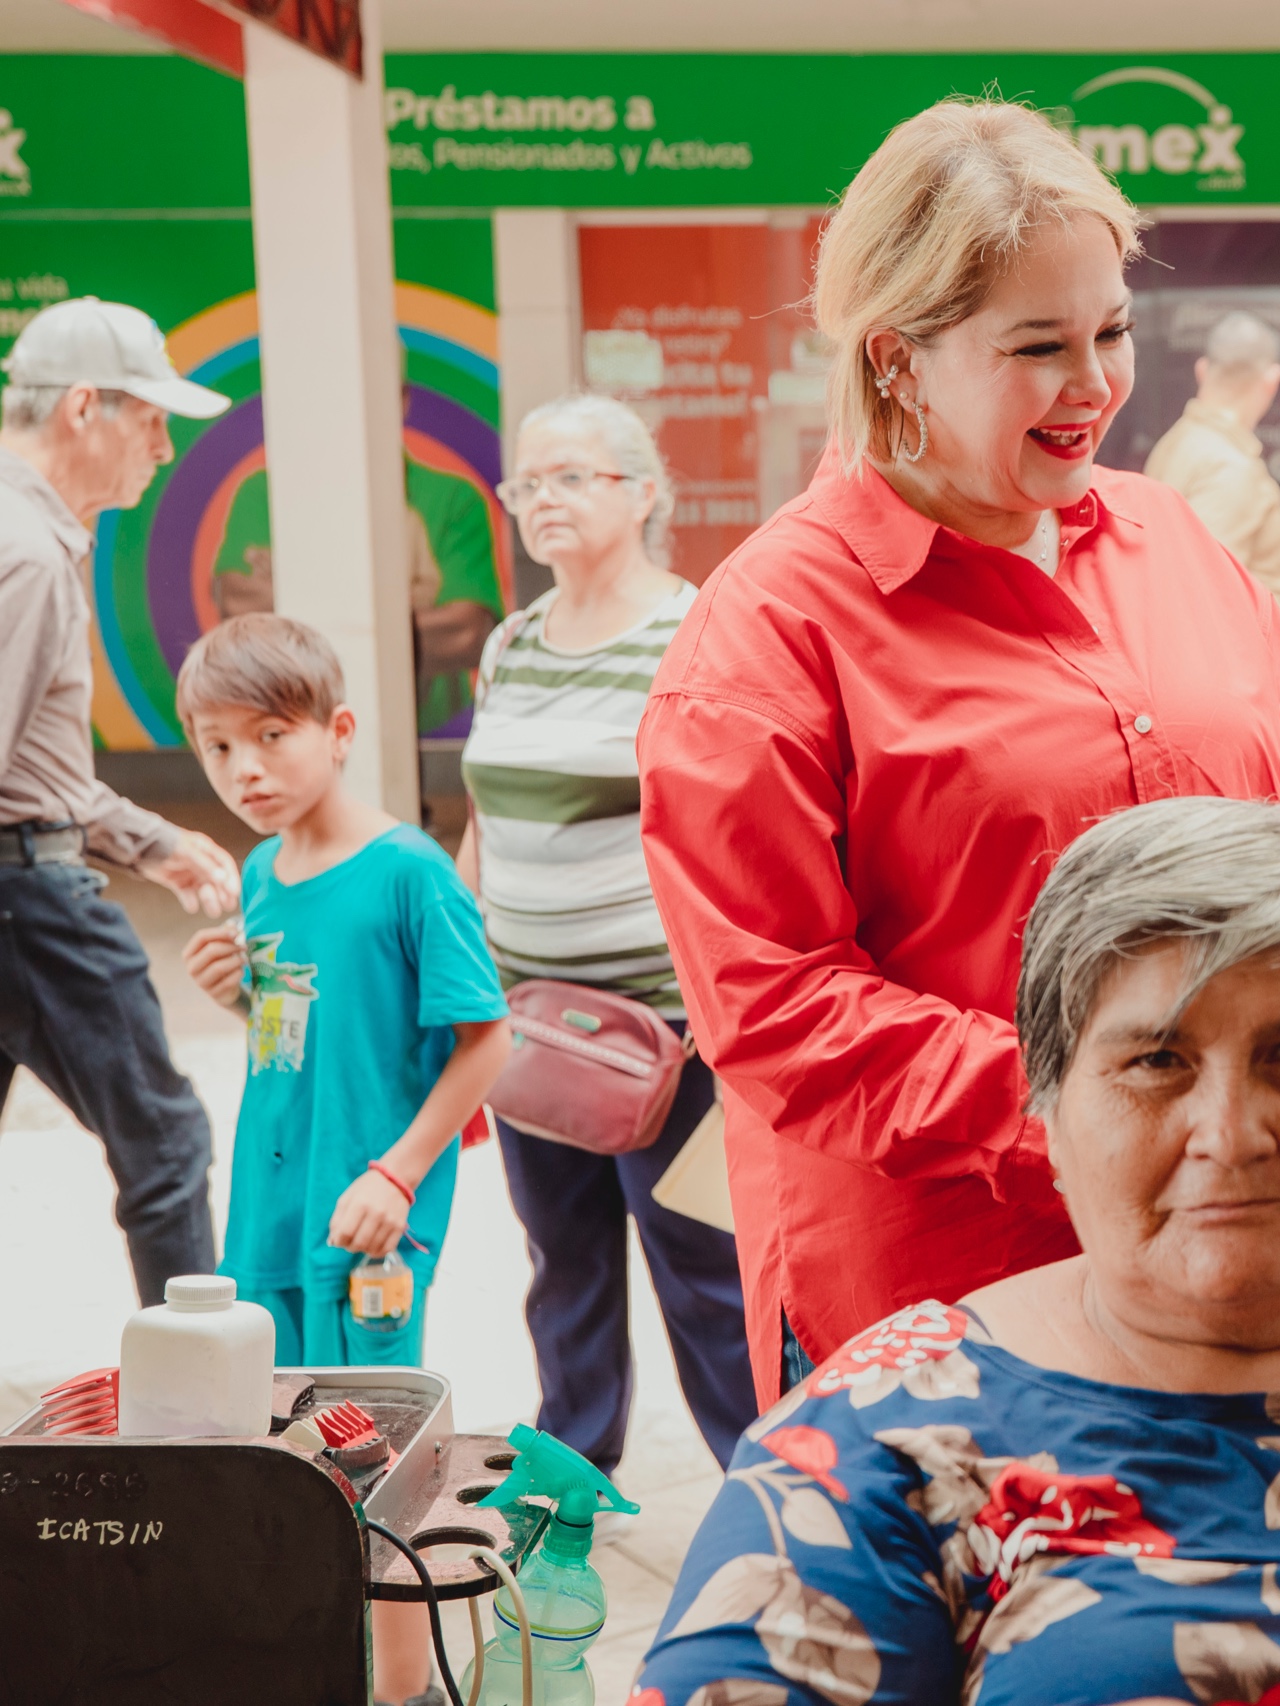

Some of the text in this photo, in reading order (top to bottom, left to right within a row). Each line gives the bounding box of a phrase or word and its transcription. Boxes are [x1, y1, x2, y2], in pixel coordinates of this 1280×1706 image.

[386, 85, 655, 130] Préstamos a
[434, 138, 616, 170] Pensionados
[620, 144, 642, 175] y
[646, 138, 752, 169] Activos
[37, 1517, 164, 1546] ICATSIN
